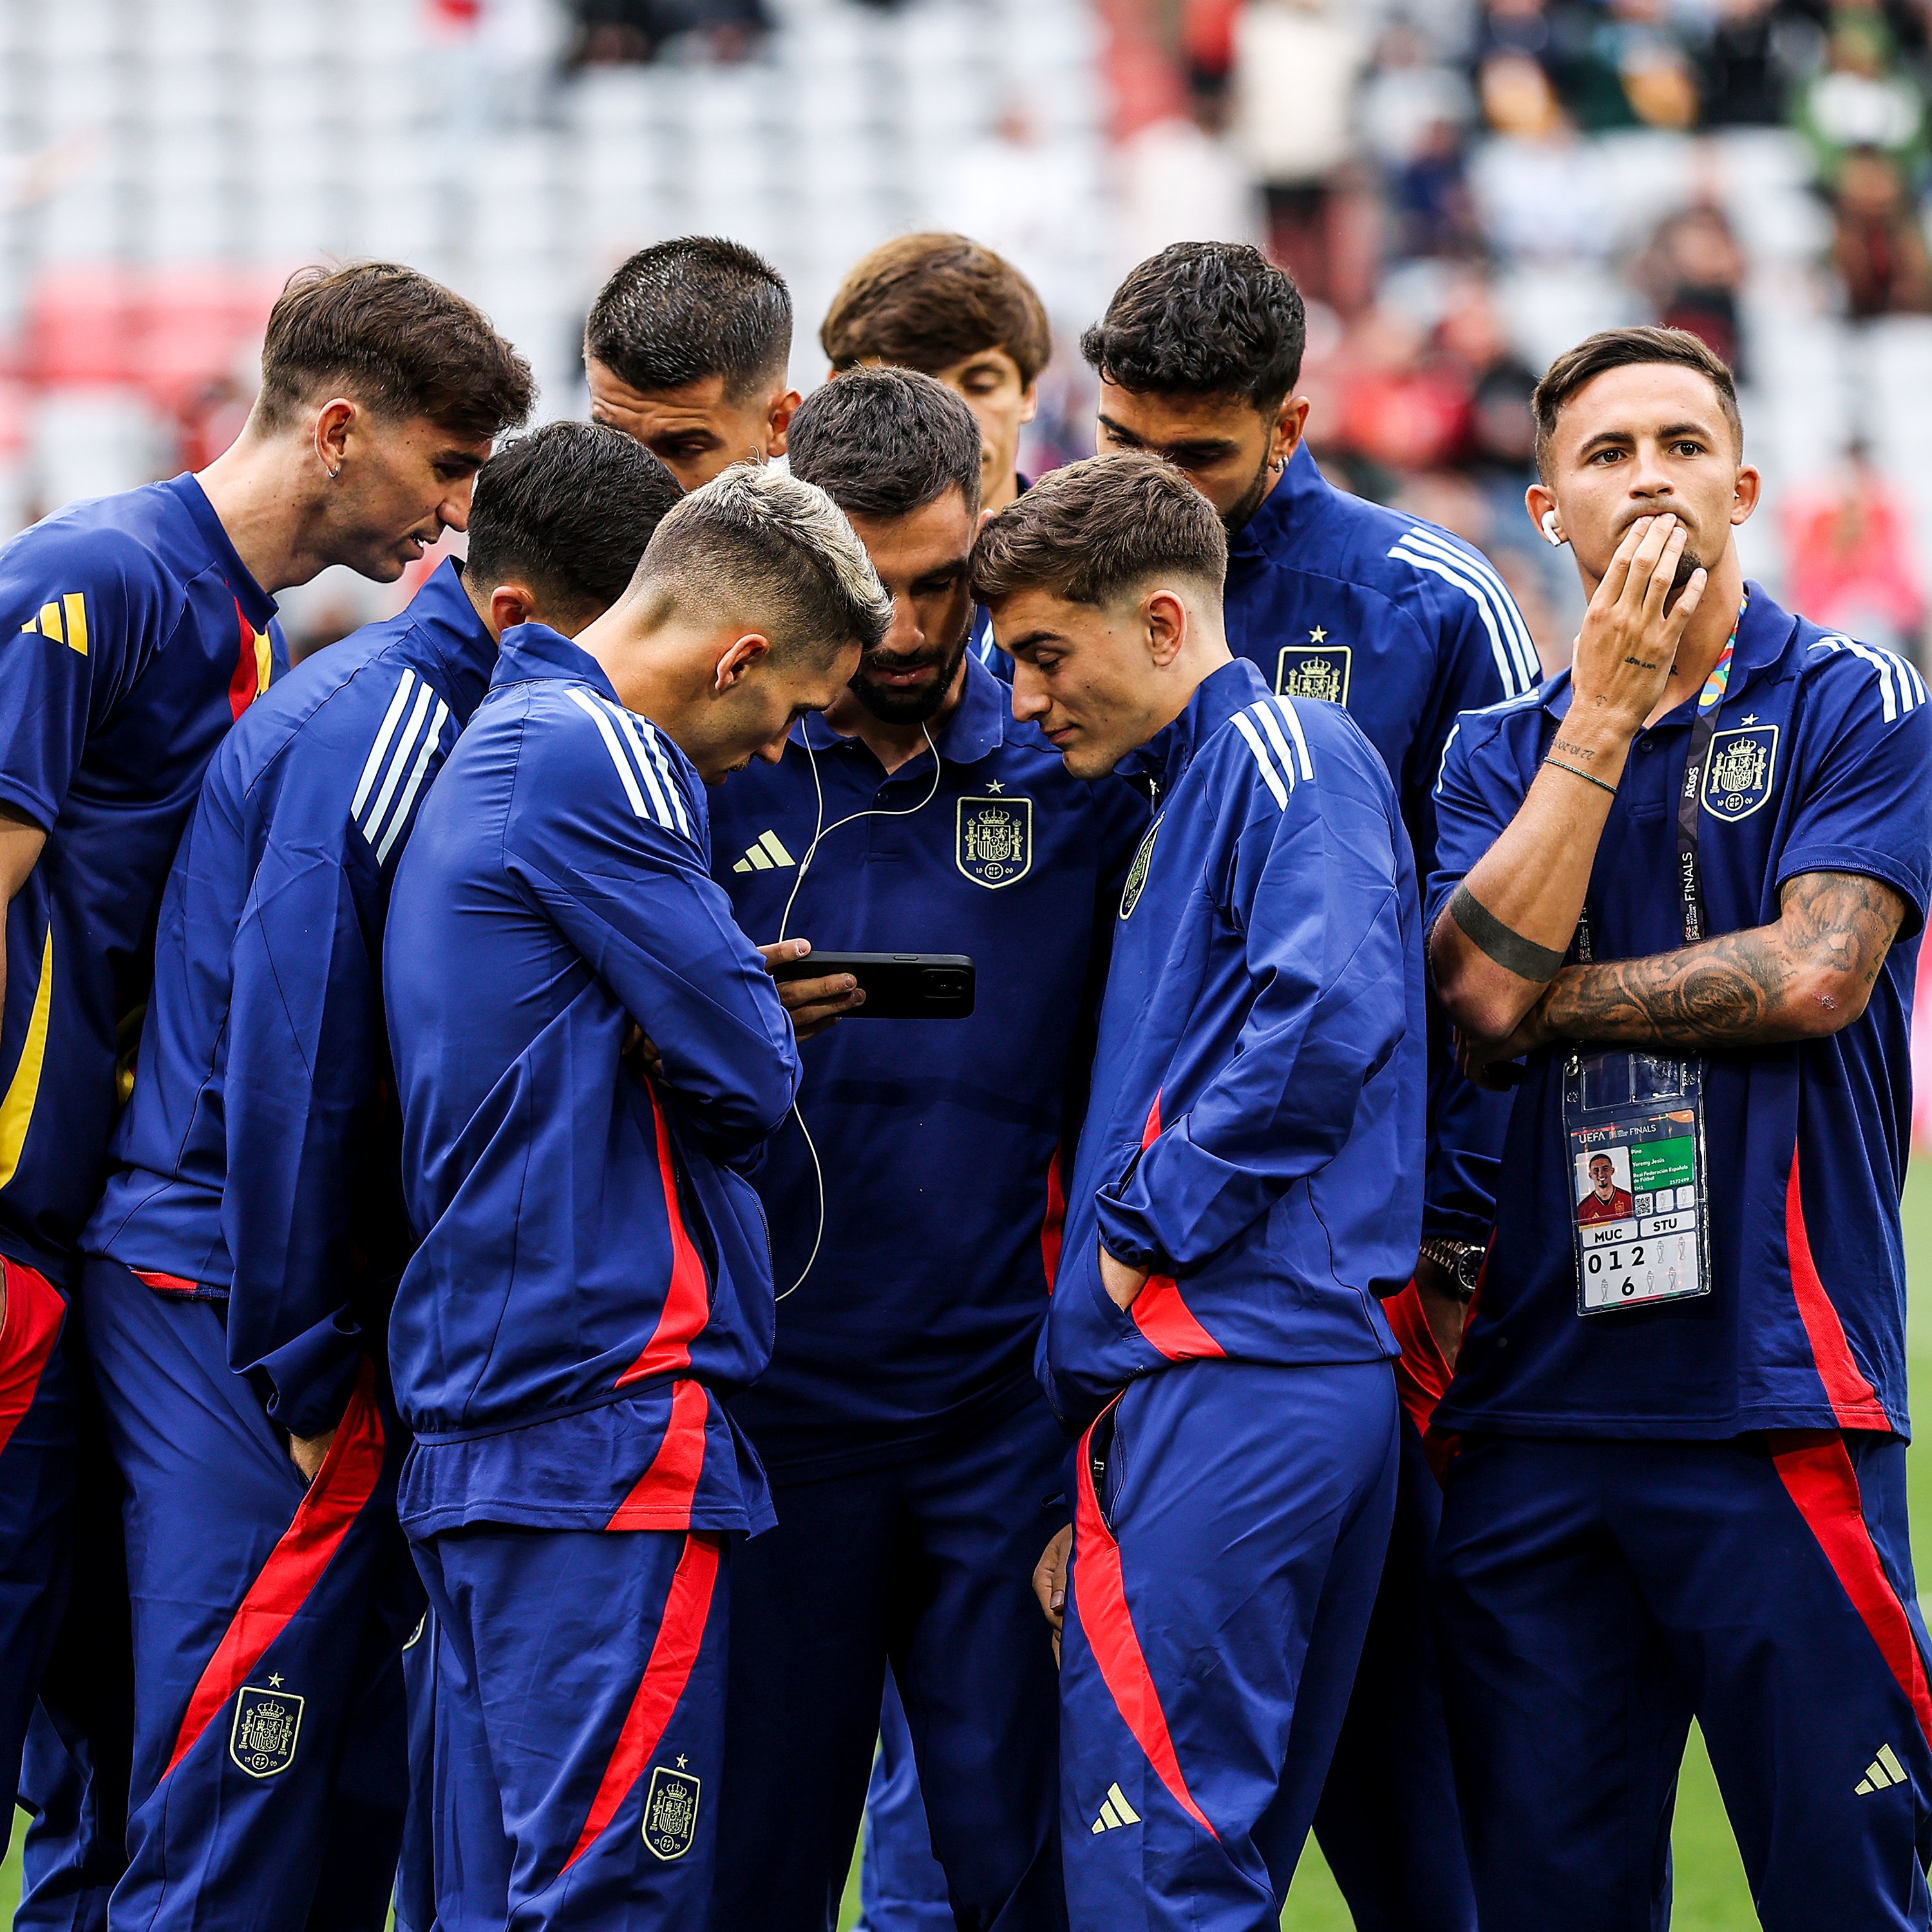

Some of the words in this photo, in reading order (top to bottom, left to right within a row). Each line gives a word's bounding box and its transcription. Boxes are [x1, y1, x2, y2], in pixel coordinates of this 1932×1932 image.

[1685, 766, 1699, 799] Atos
[1682, 852, 1695, 902] FINALS
[1578, 1131, 1606, 1144] UEFA
[1629, 1124, 1657, 1135] FINALS
[1653, 1218, 1678, 1233] STU
[1595, 1228, 1622, 1244] MUC
[1588, 1254, 1602, 1274] 0
[1609, 1251, 1622, 1271] 1
[1631, 1246, 1645, 1267] 2
[1622, 1276, 1634, 1296] 6
